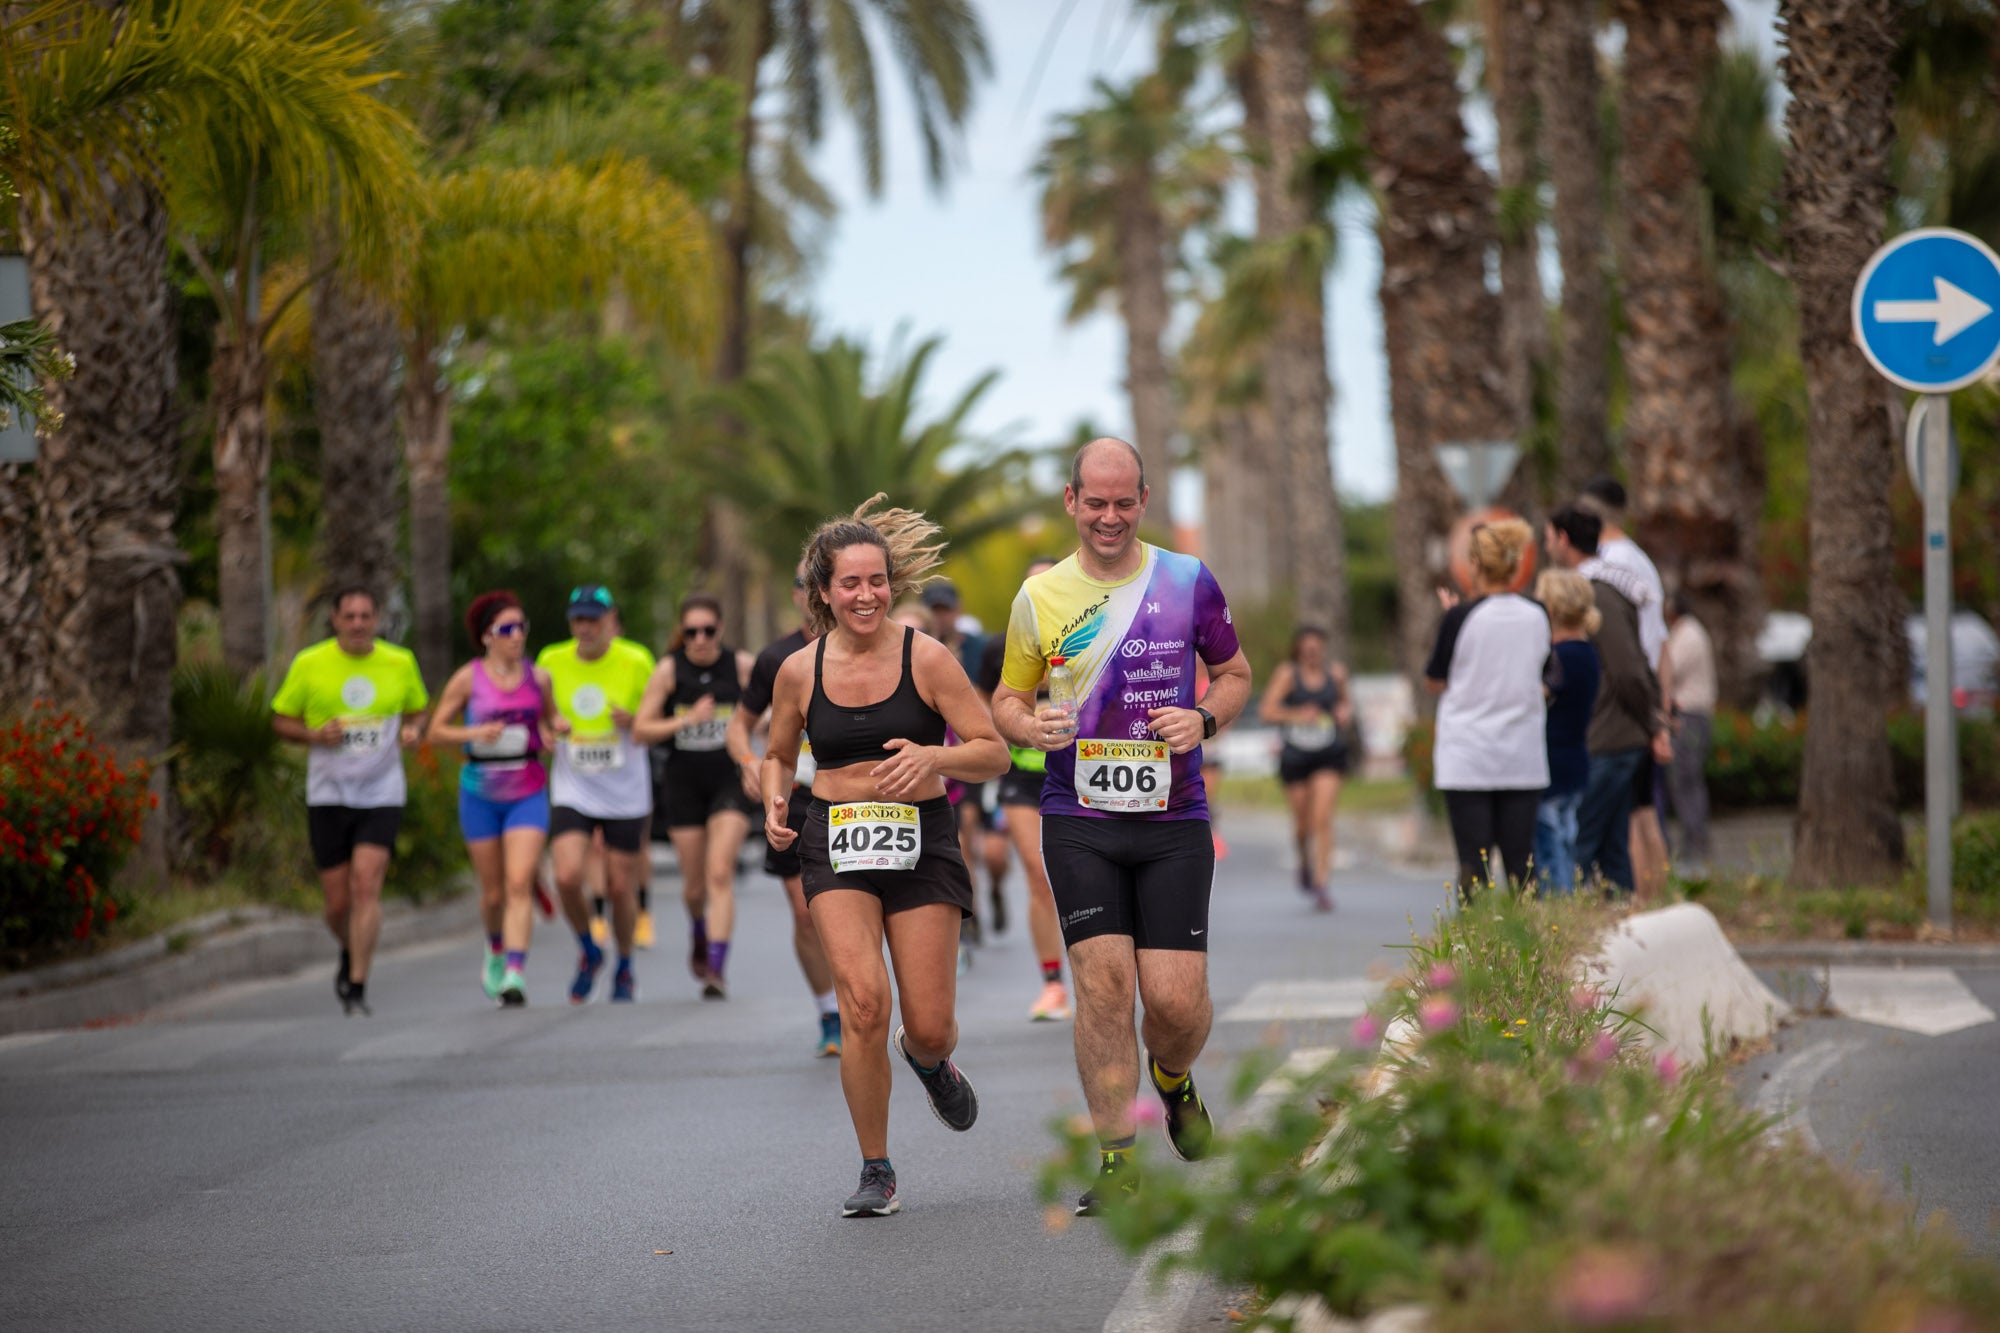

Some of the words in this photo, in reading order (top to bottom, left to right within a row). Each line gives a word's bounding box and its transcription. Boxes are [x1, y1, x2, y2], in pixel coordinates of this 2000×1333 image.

[1149, 639, 1185, 651] Arrebola
[1123, 666, 1181, 680] Valleaguirre
[1124, 686, 1179, 703] OKEYMAS
[1124, 702, 1162, 710] FITNESS
[1090, 743, 1104, 756] 38
[1104, 748, 1151, 757] FONDO
[1089, 765, 1157, 793] 406
[841, 808, 854, 820] 38
[854, 808, 901, 819] FONDO
[831, 825, 917, 853] 4025
[1068, 906, 1104, 920] olimpo
